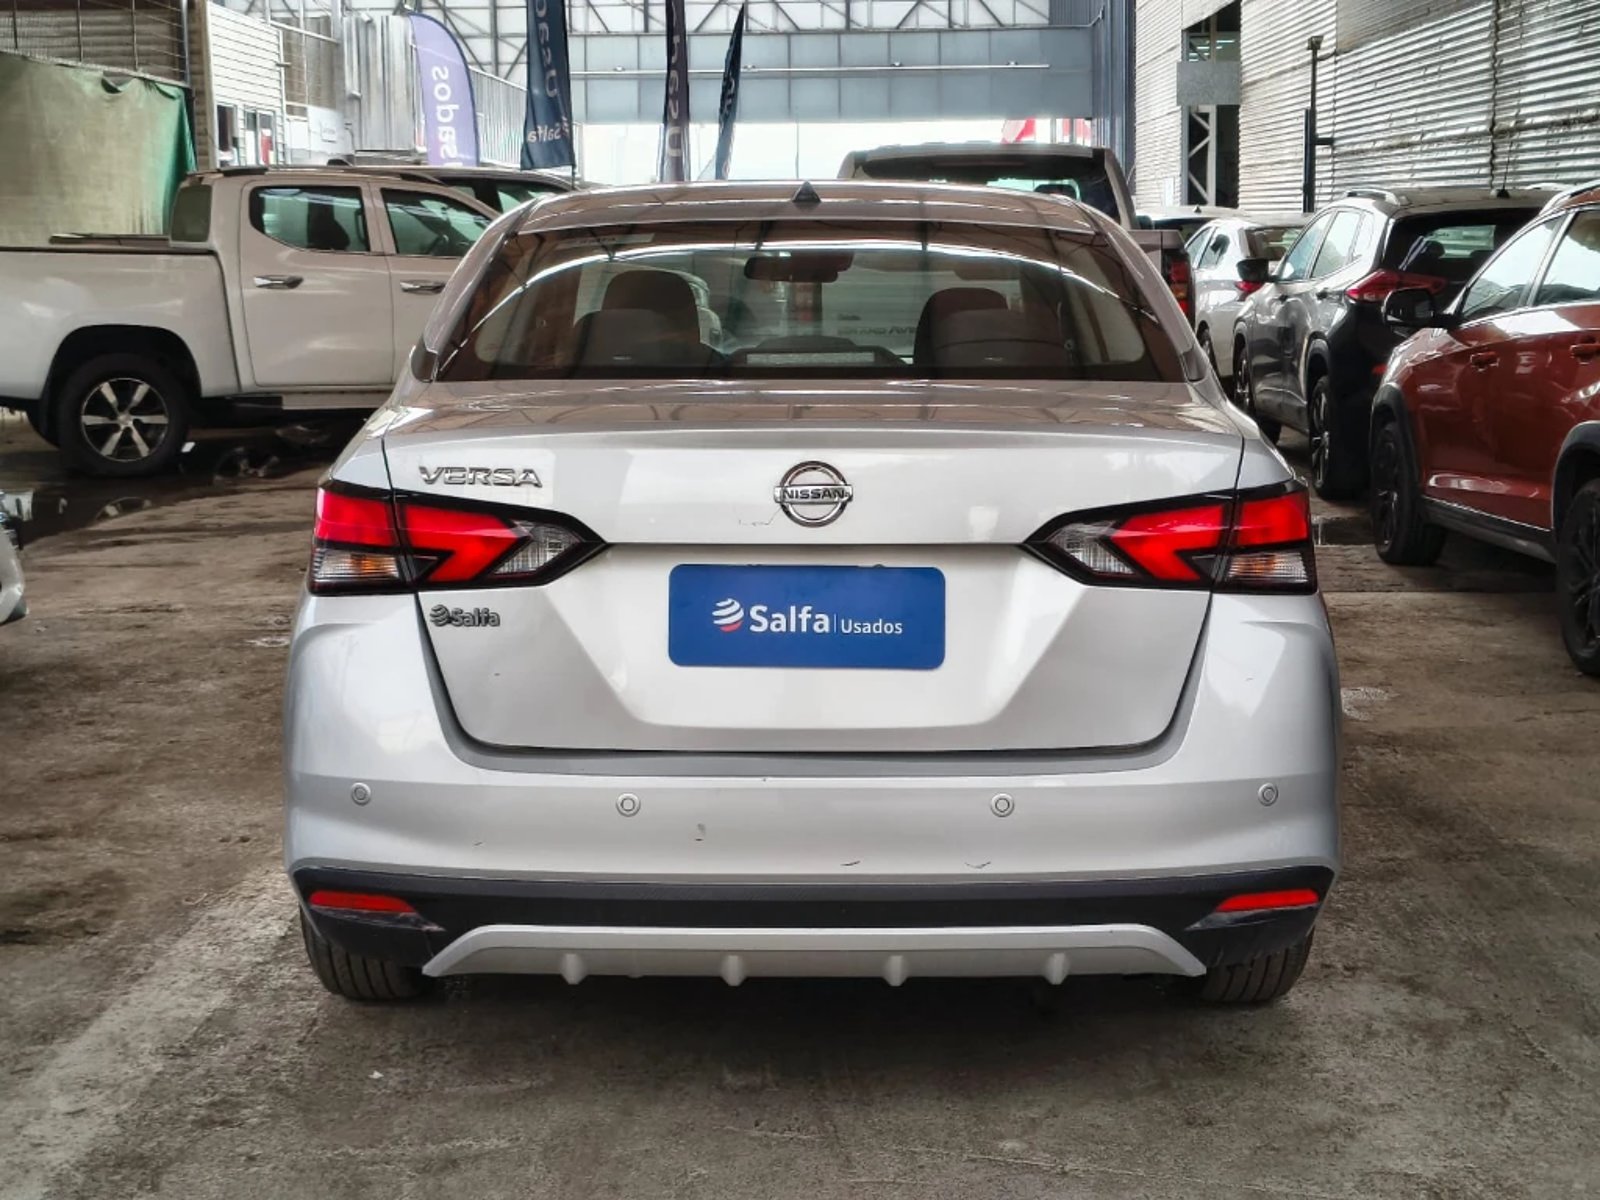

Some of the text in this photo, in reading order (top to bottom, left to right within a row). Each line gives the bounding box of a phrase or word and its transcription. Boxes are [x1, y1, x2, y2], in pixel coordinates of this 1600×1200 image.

[419, 466, 543, 488] VERSA
[783, 488, 845, 499] NISSAN
[451, 607, 501, 627] Salfa
[749, 605, 903, 634] Salfa Usados
